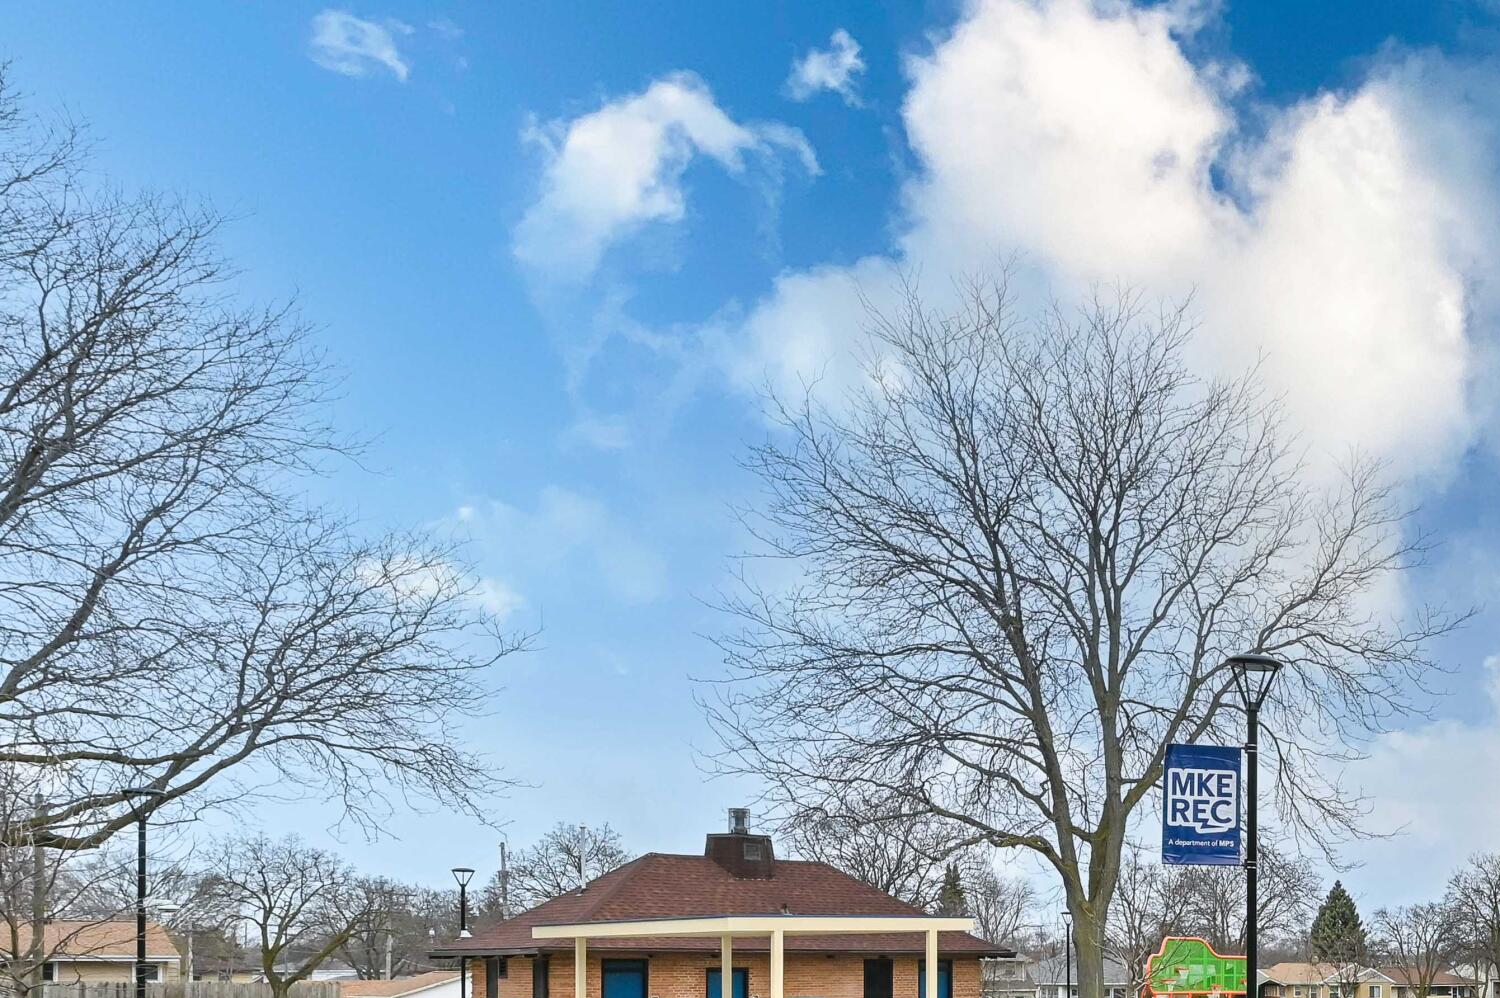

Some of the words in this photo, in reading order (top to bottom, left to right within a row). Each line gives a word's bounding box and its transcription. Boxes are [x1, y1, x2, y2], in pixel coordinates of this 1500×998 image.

[1171, 772, 1233, 798] MKE
[1171, 798, 1233, 827] REC
[1175, 838, 1211, 848] department
